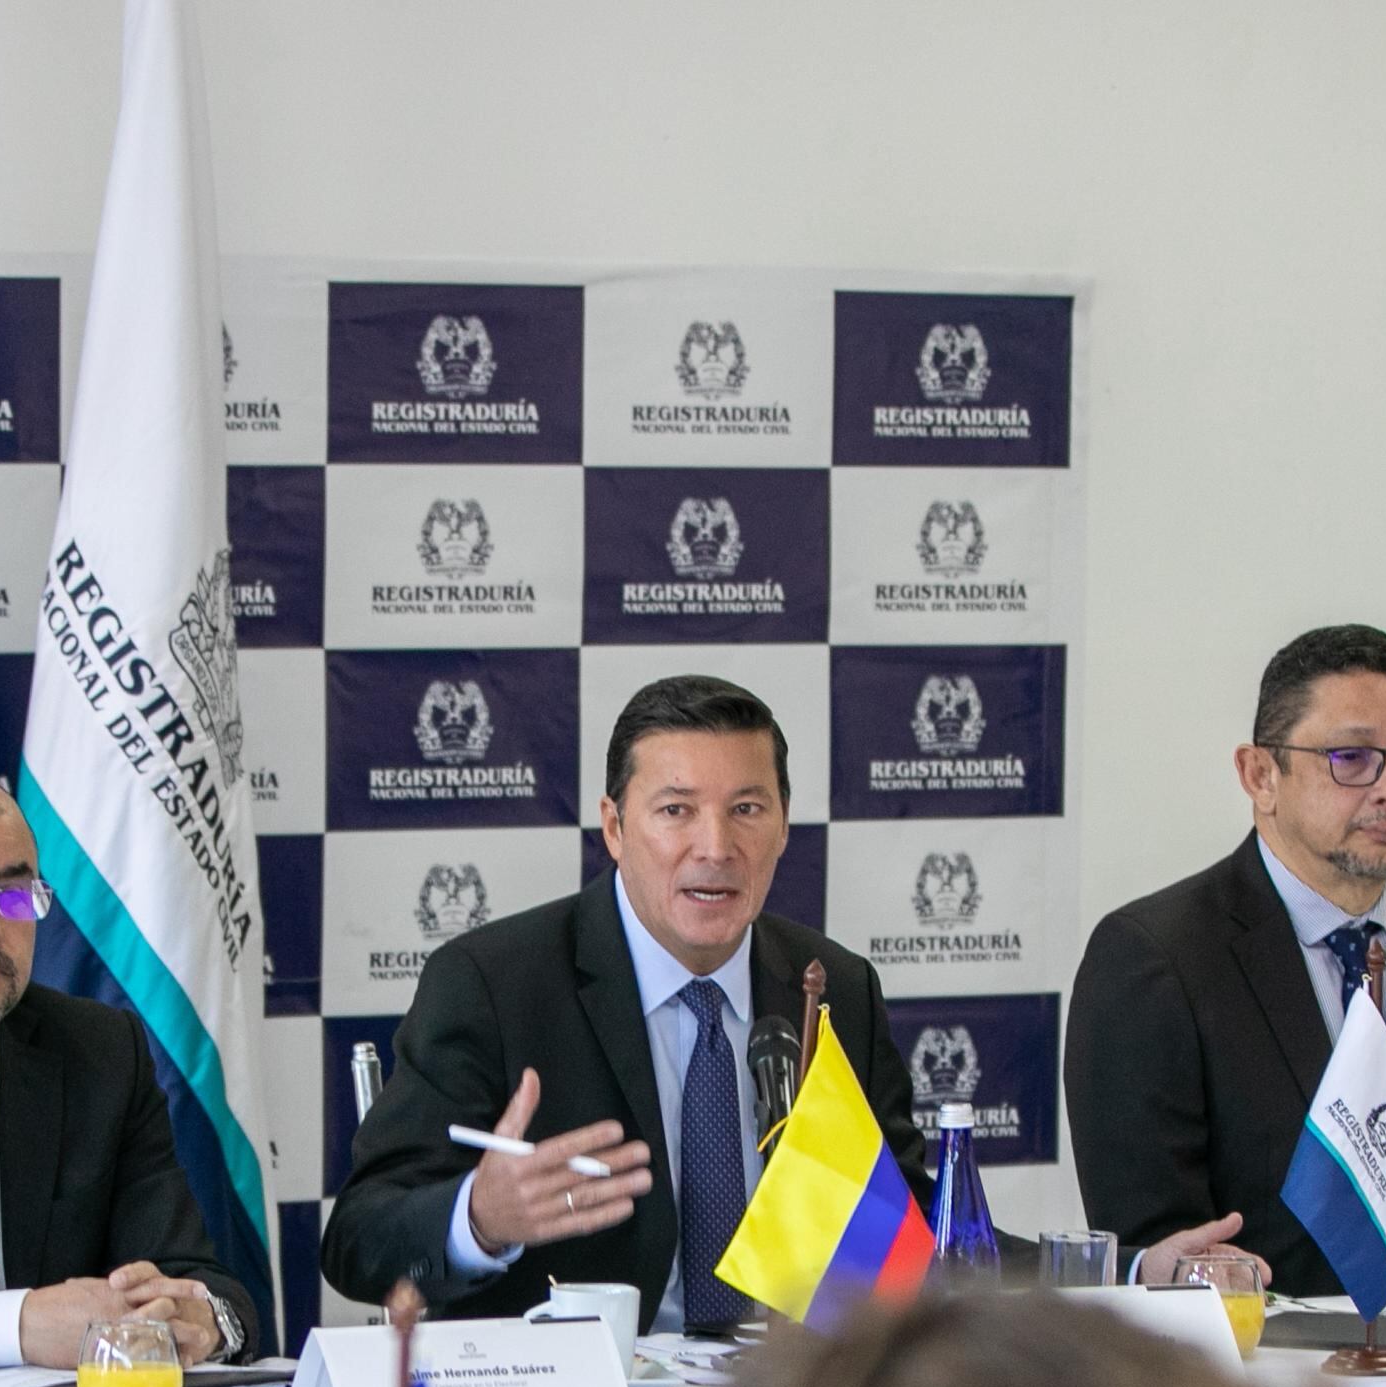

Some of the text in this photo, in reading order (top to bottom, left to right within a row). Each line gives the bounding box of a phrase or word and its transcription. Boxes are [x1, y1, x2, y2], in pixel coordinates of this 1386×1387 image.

[372, 398, 539, 420] REGISTRADURÍA
[632, 400, 791, 421] REGISTRADURÍA
[873, 403, 1031, 426] REGISTRADURÍA
[251, 421, 281, 431] CIVIL
[372, 422, 539, 434] NACIONAL DEL ESTADO CIVIL
[632, 424, 791, 435] NACIONAL DEL ESTADO CIVIL
[873, 427, 1031, 438] NACIONAL DEL ESTADO CIVIL
[372, 580, 535, 600] REGISTRADURÍA
[623, 578, 785, 600] REGISTRADURÍA
[875, 579, 1027, 599] REGISTRADURÍA
[244, 605, 276, 616] CIVIL
[372, 604, 536, 614] NACIONAL DEL ESTADO CIVIL
[623, 602, 785, 614] NACIONAL DEL ESTADO CIVIL
[875, 602, 1027, 611] NACIONAL DEL ESTADO CIVIL
[55, 537, 252, 945] REGISTRADURÍA
[870, 754, 1025, 778] REGISTRADURÍA
[370, 761, 535, 786] REGISTRADURÍA
[870, 778, 1025, 790] NACIONAL DEL ESTADO CIVIL
[370, 787, 536, 800] NACIONAL DEL ESTADO CIVIL
[105, 712, 155, 776] DEL
[152, 775, 220, 889] ESTADO
[217, 895, 240, 974] CIVIL
[870, 929, 1021, 952] REGISTRADURÍA
[870, 952, 1021, 964] NACIONAL DEL ESTADO CIVIL
[991, 1127, 1019, 1137] CIVIL
[445, 1366, 509, 1379] Hernando
[512, 1363, 556, 1375] Suárez
